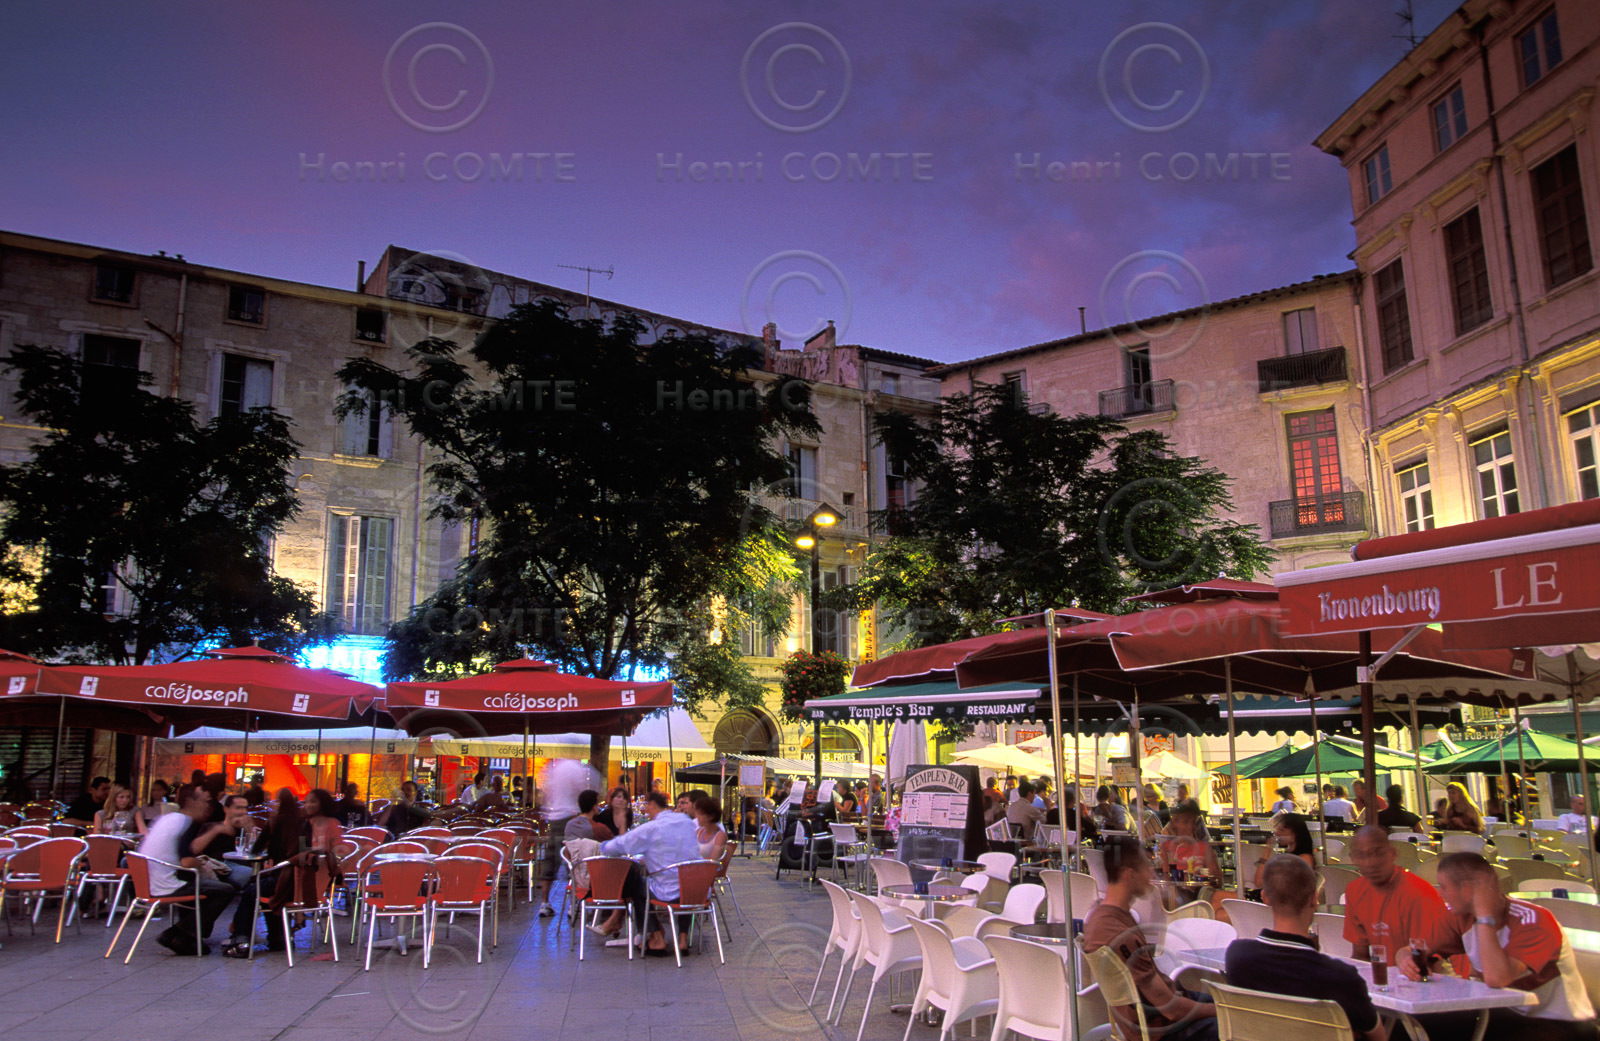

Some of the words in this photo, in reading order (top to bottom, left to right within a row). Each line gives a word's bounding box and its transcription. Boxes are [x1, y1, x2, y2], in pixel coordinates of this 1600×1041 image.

[1317, 584, 1441, 622] Kronenbourg
[1489, 561, 1563, 610] LE
[145, 682, 249, 707] caféjoseph
[483, 692, 579, 711] caféjoseph
[811, 710, 825, 718] BAR
[848, 704, 904, 719] Temple's
[908, 703, 935, 717] Bar
[966, 703, 1027, 716] RESTAURANT
[498, 745, 544, 757] caféjoeph
[803, 753, 830, 761] MOES
[833, 753, 856, 761] FRITES
[910, 769, 947, 790] TEMPLE'S
[947, 771, 966, 792] BAR
